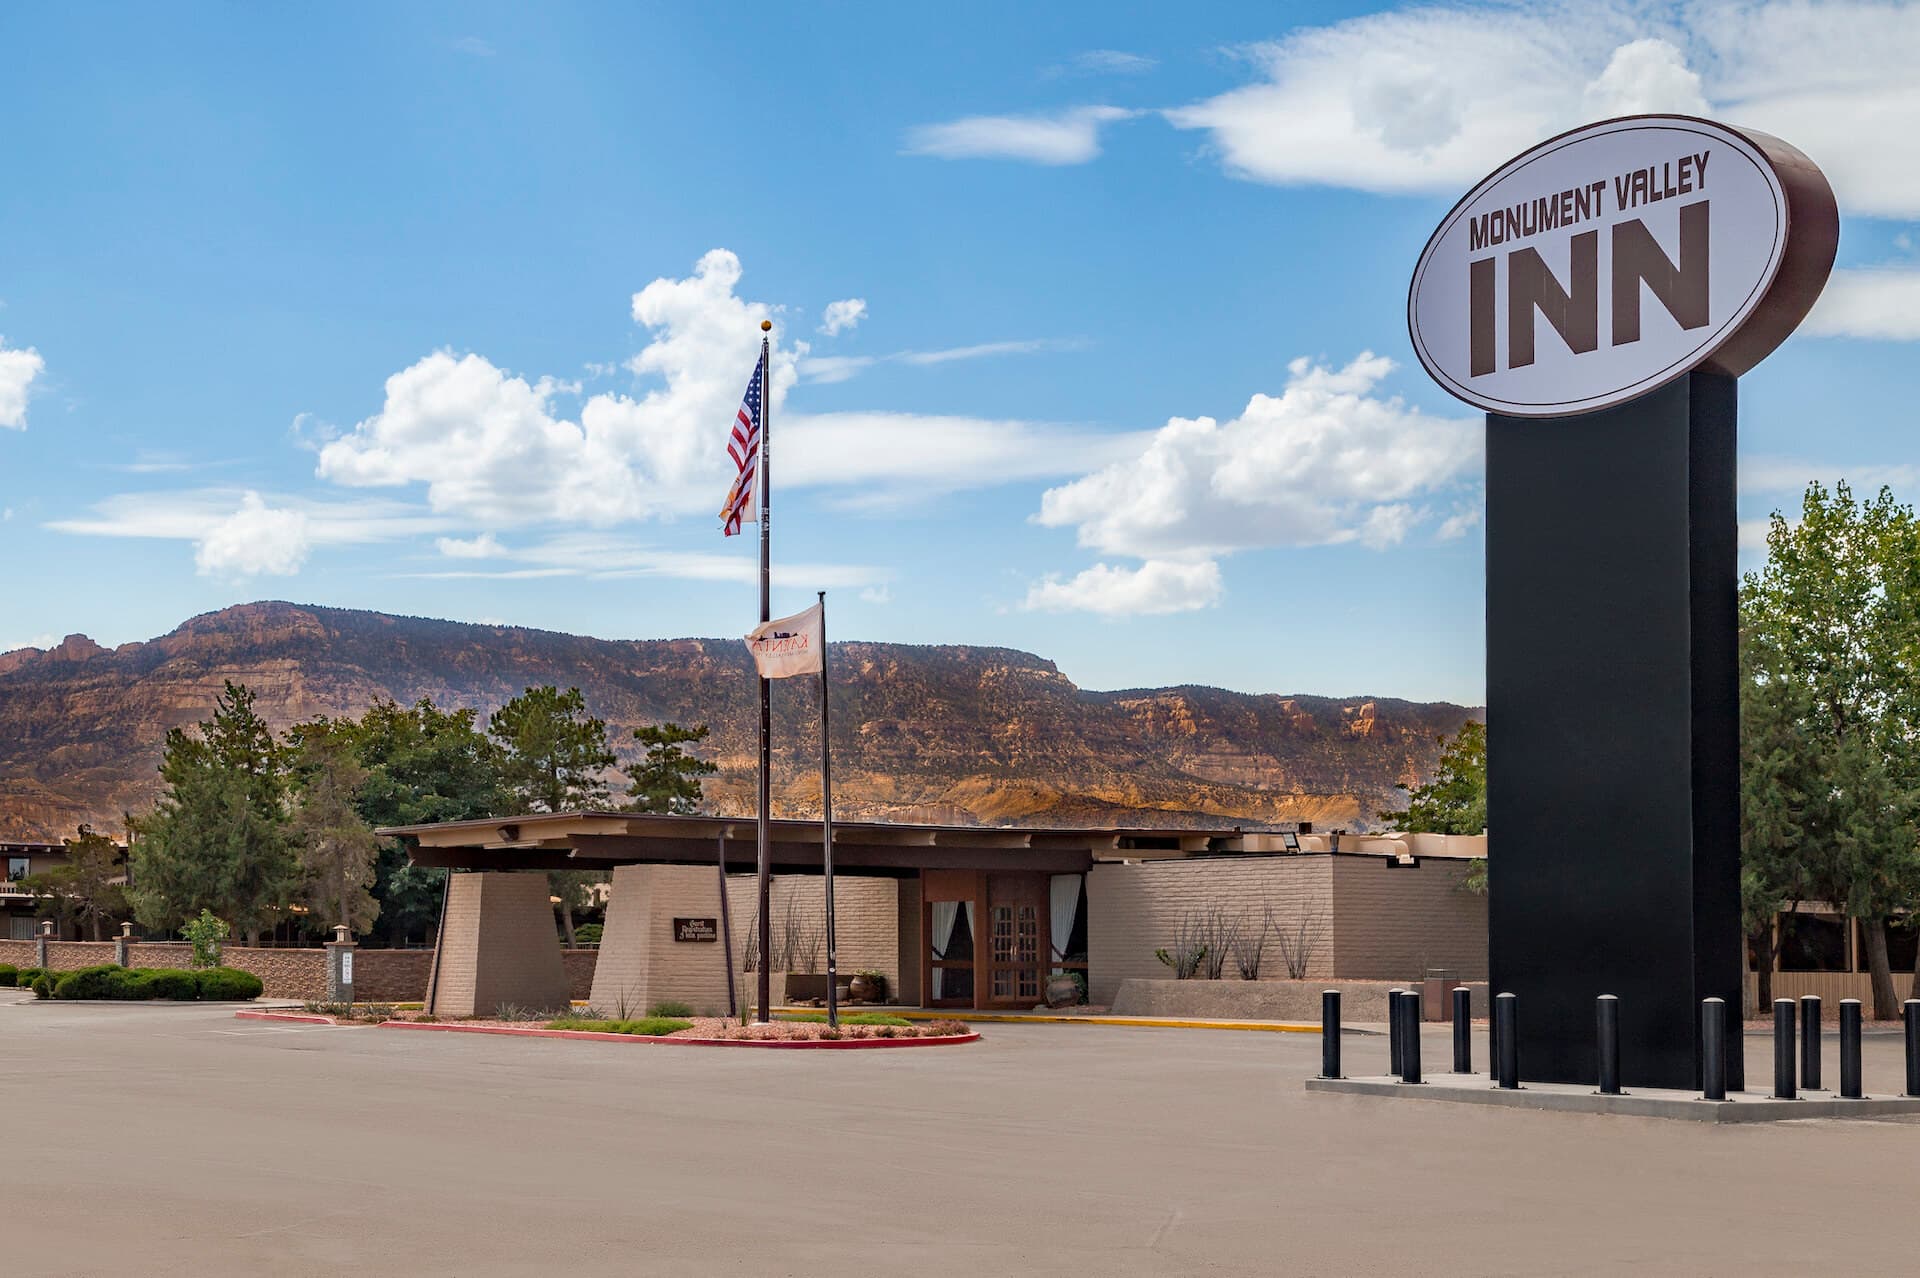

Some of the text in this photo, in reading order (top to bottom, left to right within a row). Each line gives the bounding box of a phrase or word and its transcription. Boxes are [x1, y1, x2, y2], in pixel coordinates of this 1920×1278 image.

[1470, 150, 1710, 251] MONUMENT VALLEY
[1469, 200, 1710, 378] INN
